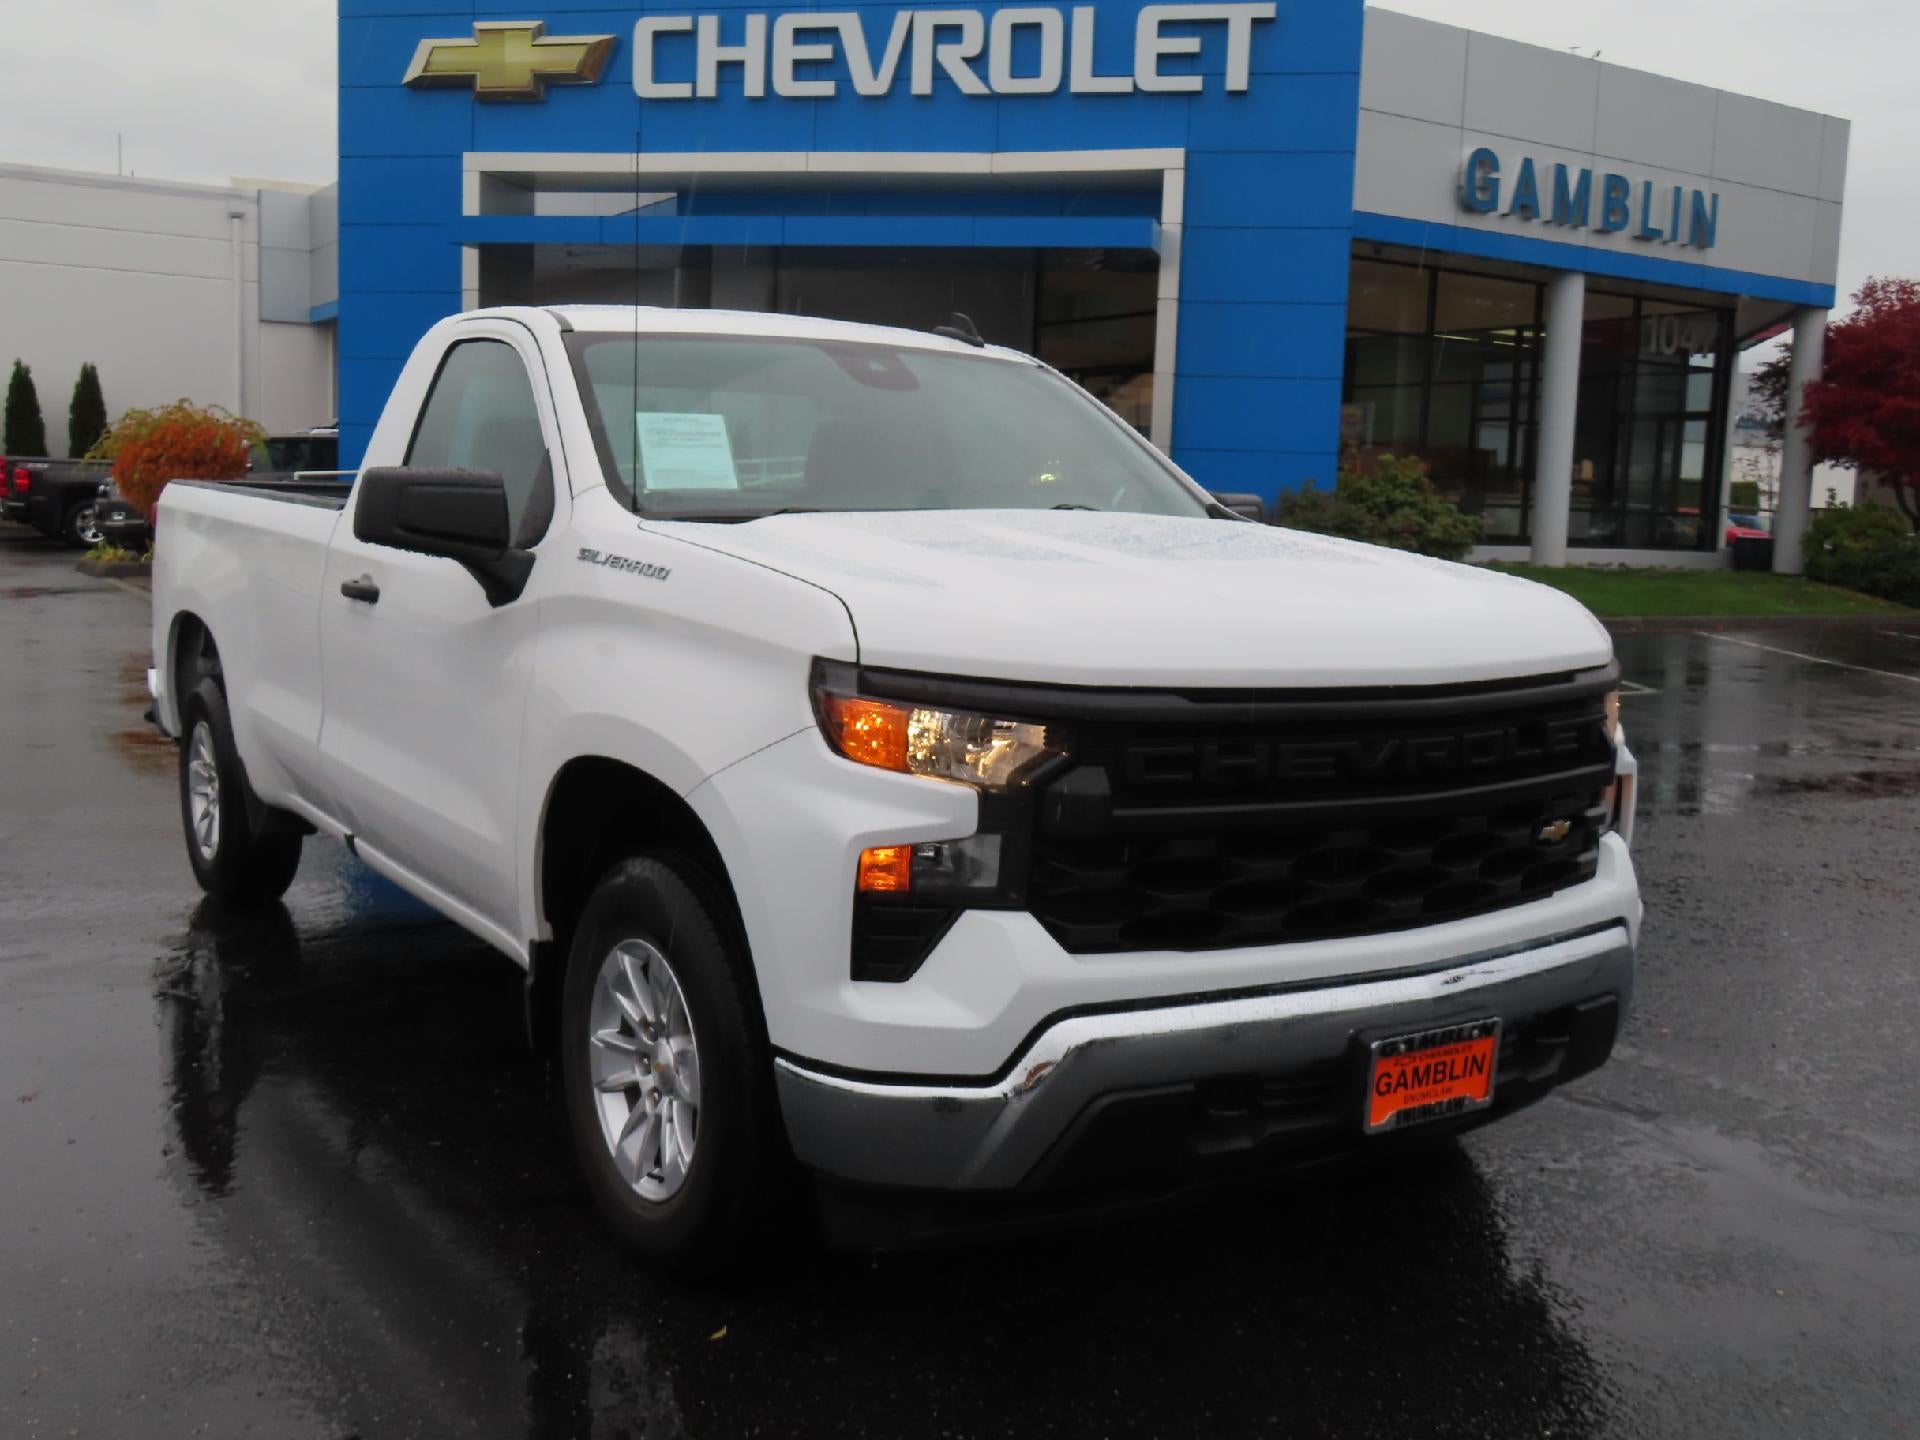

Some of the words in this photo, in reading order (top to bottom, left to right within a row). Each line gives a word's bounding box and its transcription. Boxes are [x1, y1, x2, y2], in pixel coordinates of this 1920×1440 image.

[633, 3, 1277, 98] CHEVROLET
[1465, 147, 1719, 249] GAMBLIN
[577, 548, 672, 581] SILVERADO
[1375, 1053, 1486, 1097] GAMBLIN
